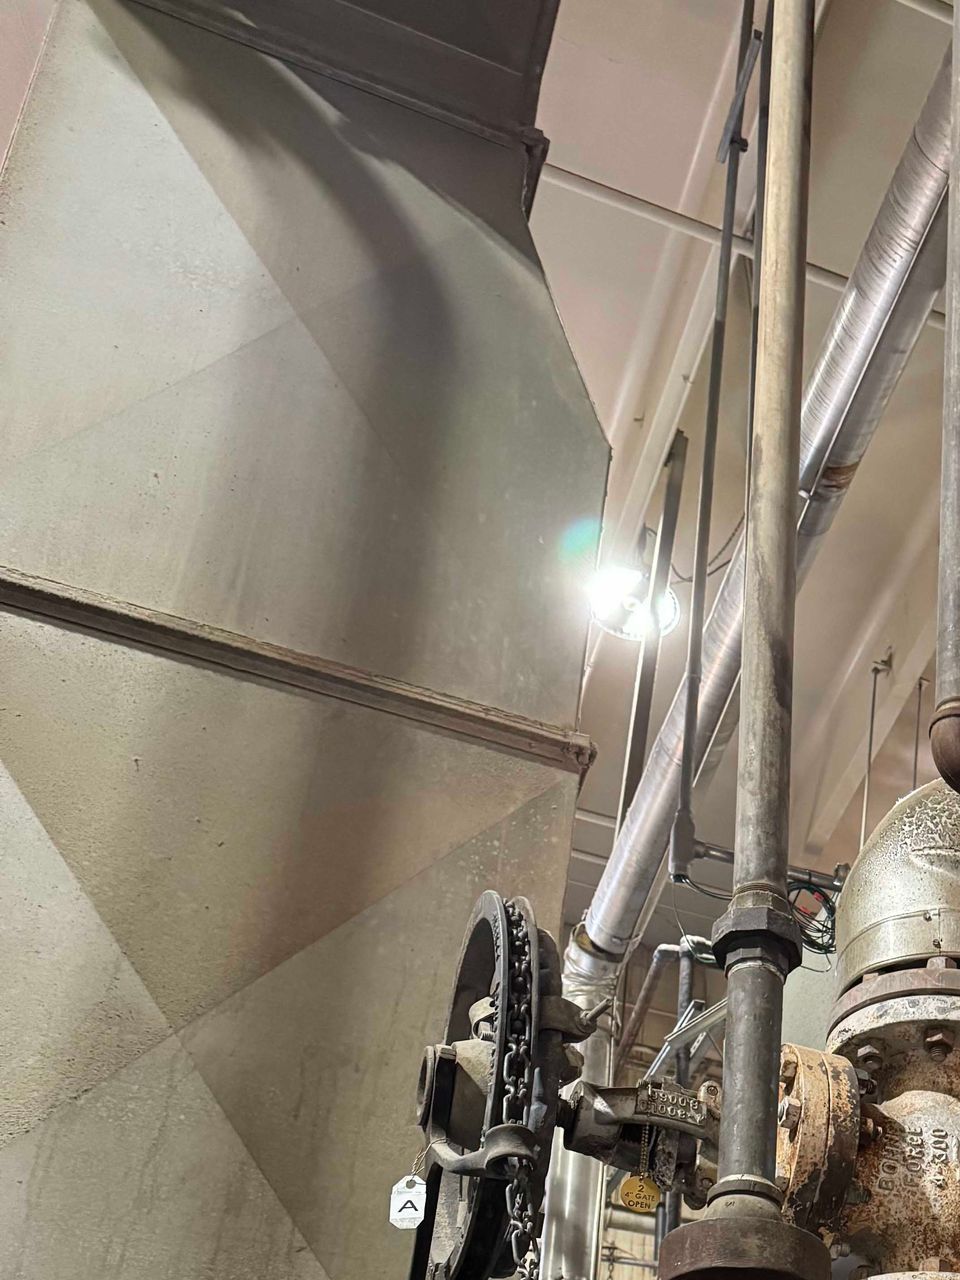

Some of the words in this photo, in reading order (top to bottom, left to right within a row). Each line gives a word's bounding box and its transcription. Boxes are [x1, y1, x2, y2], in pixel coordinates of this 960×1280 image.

[637, 1184, 645, 1193] 2
[635, 1192, 656, 1202] GATE
[398, 1200, 418, 1213] A
[627, 1199, 651, 1210] OPEN
